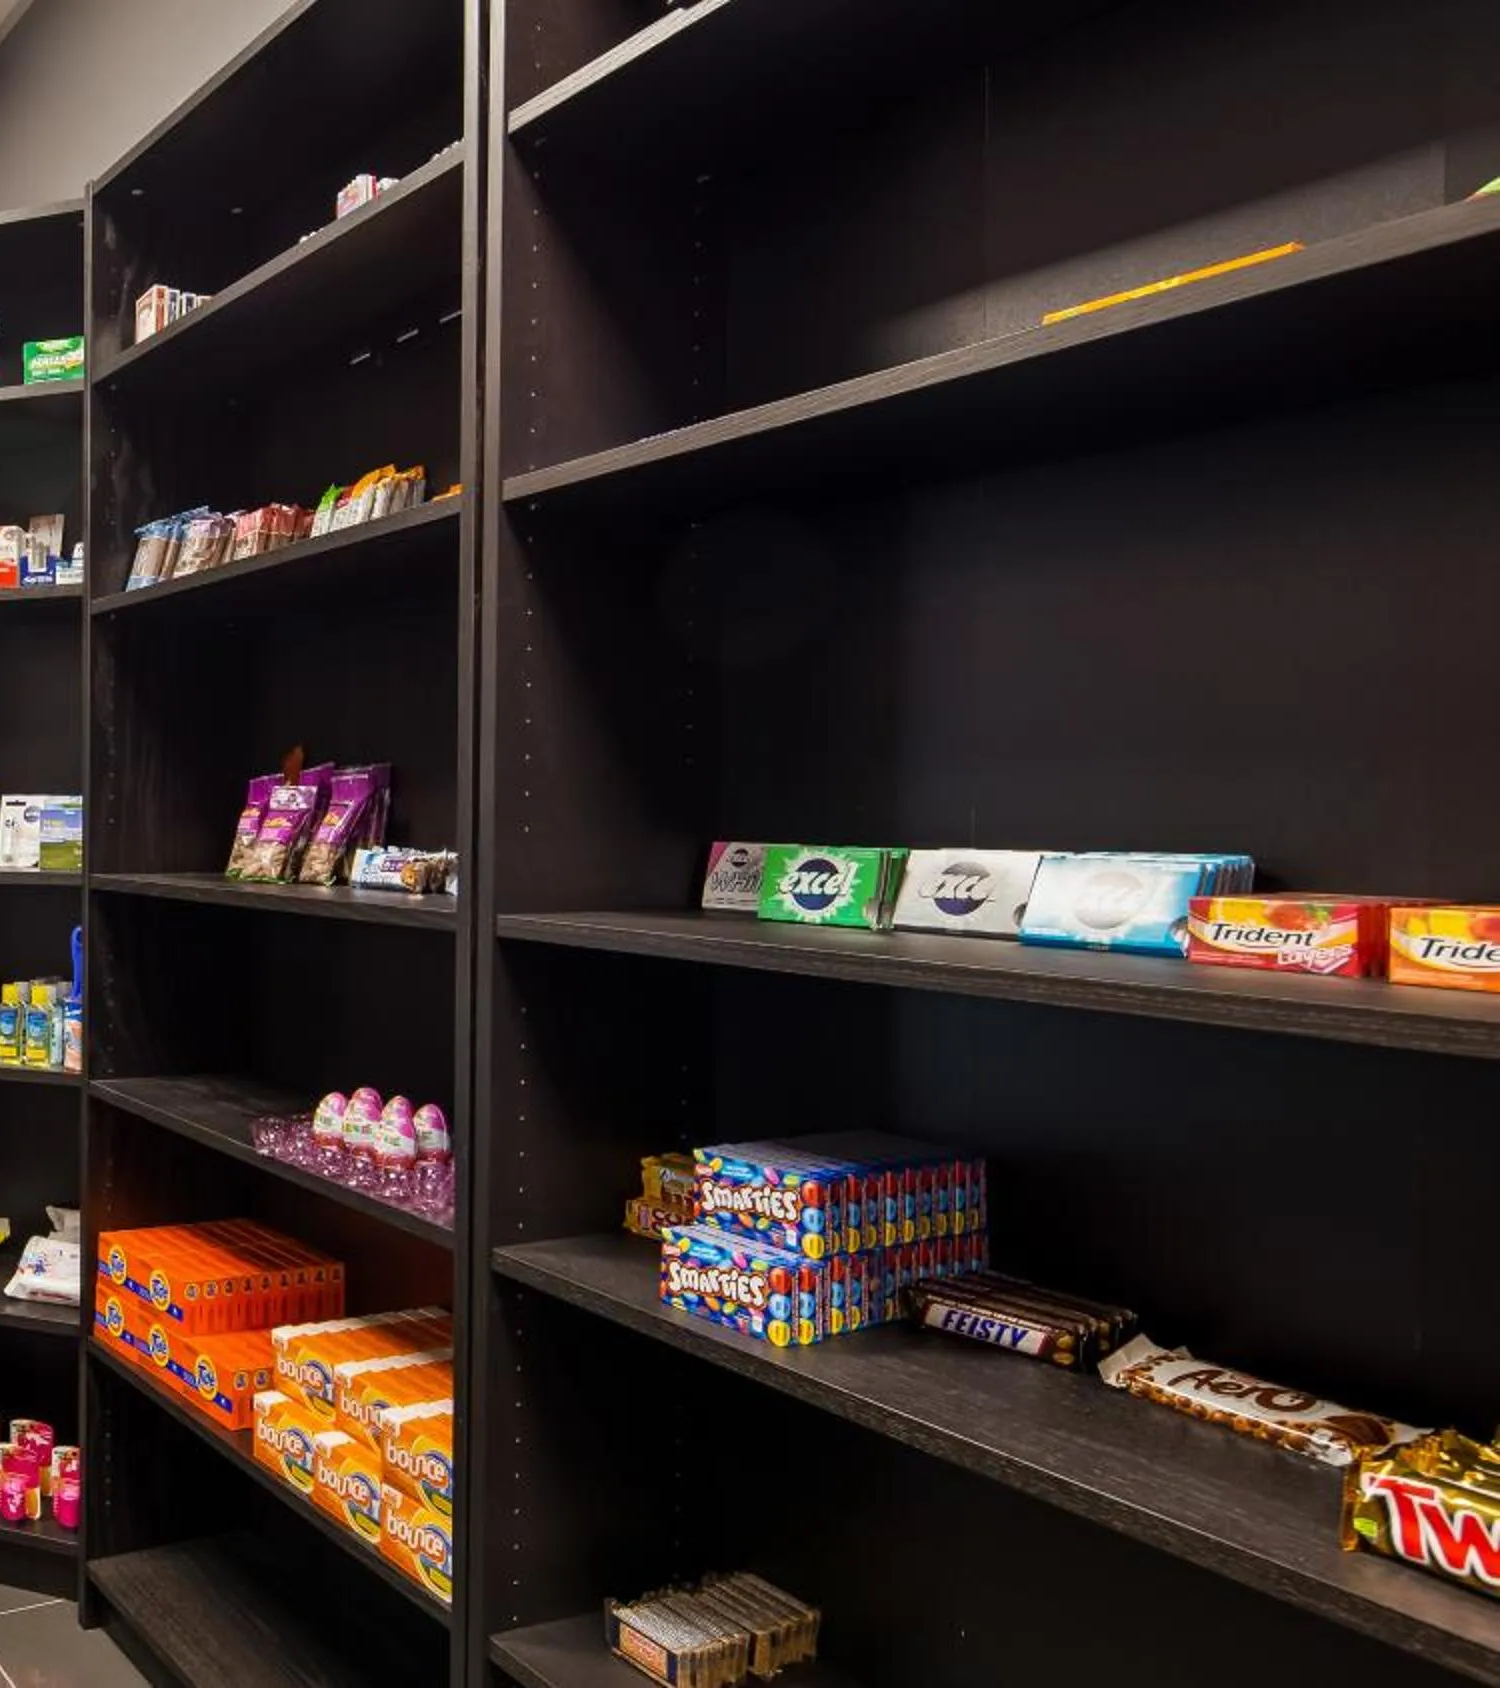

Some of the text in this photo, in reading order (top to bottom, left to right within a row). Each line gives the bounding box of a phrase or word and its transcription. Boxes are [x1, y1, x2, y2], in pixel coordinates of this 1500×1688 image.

[778, 861, 858, 896] excel
[1210, 922, 1314, 948] Trident
[1419, 937, 1500, 963] Tride
[941, 1309, 1029, 1348] FEISTY
[340, 1393, 384, 1426] bounc
[1167, 1368, 1317, 1413] Aero
[386, 1436, 447, 1481] bounce
[318, 1462, 371, 1500] bounce
[386, 1509, 445, 1557] bounce
[1361, 1472, 1500, 1586] Tw
